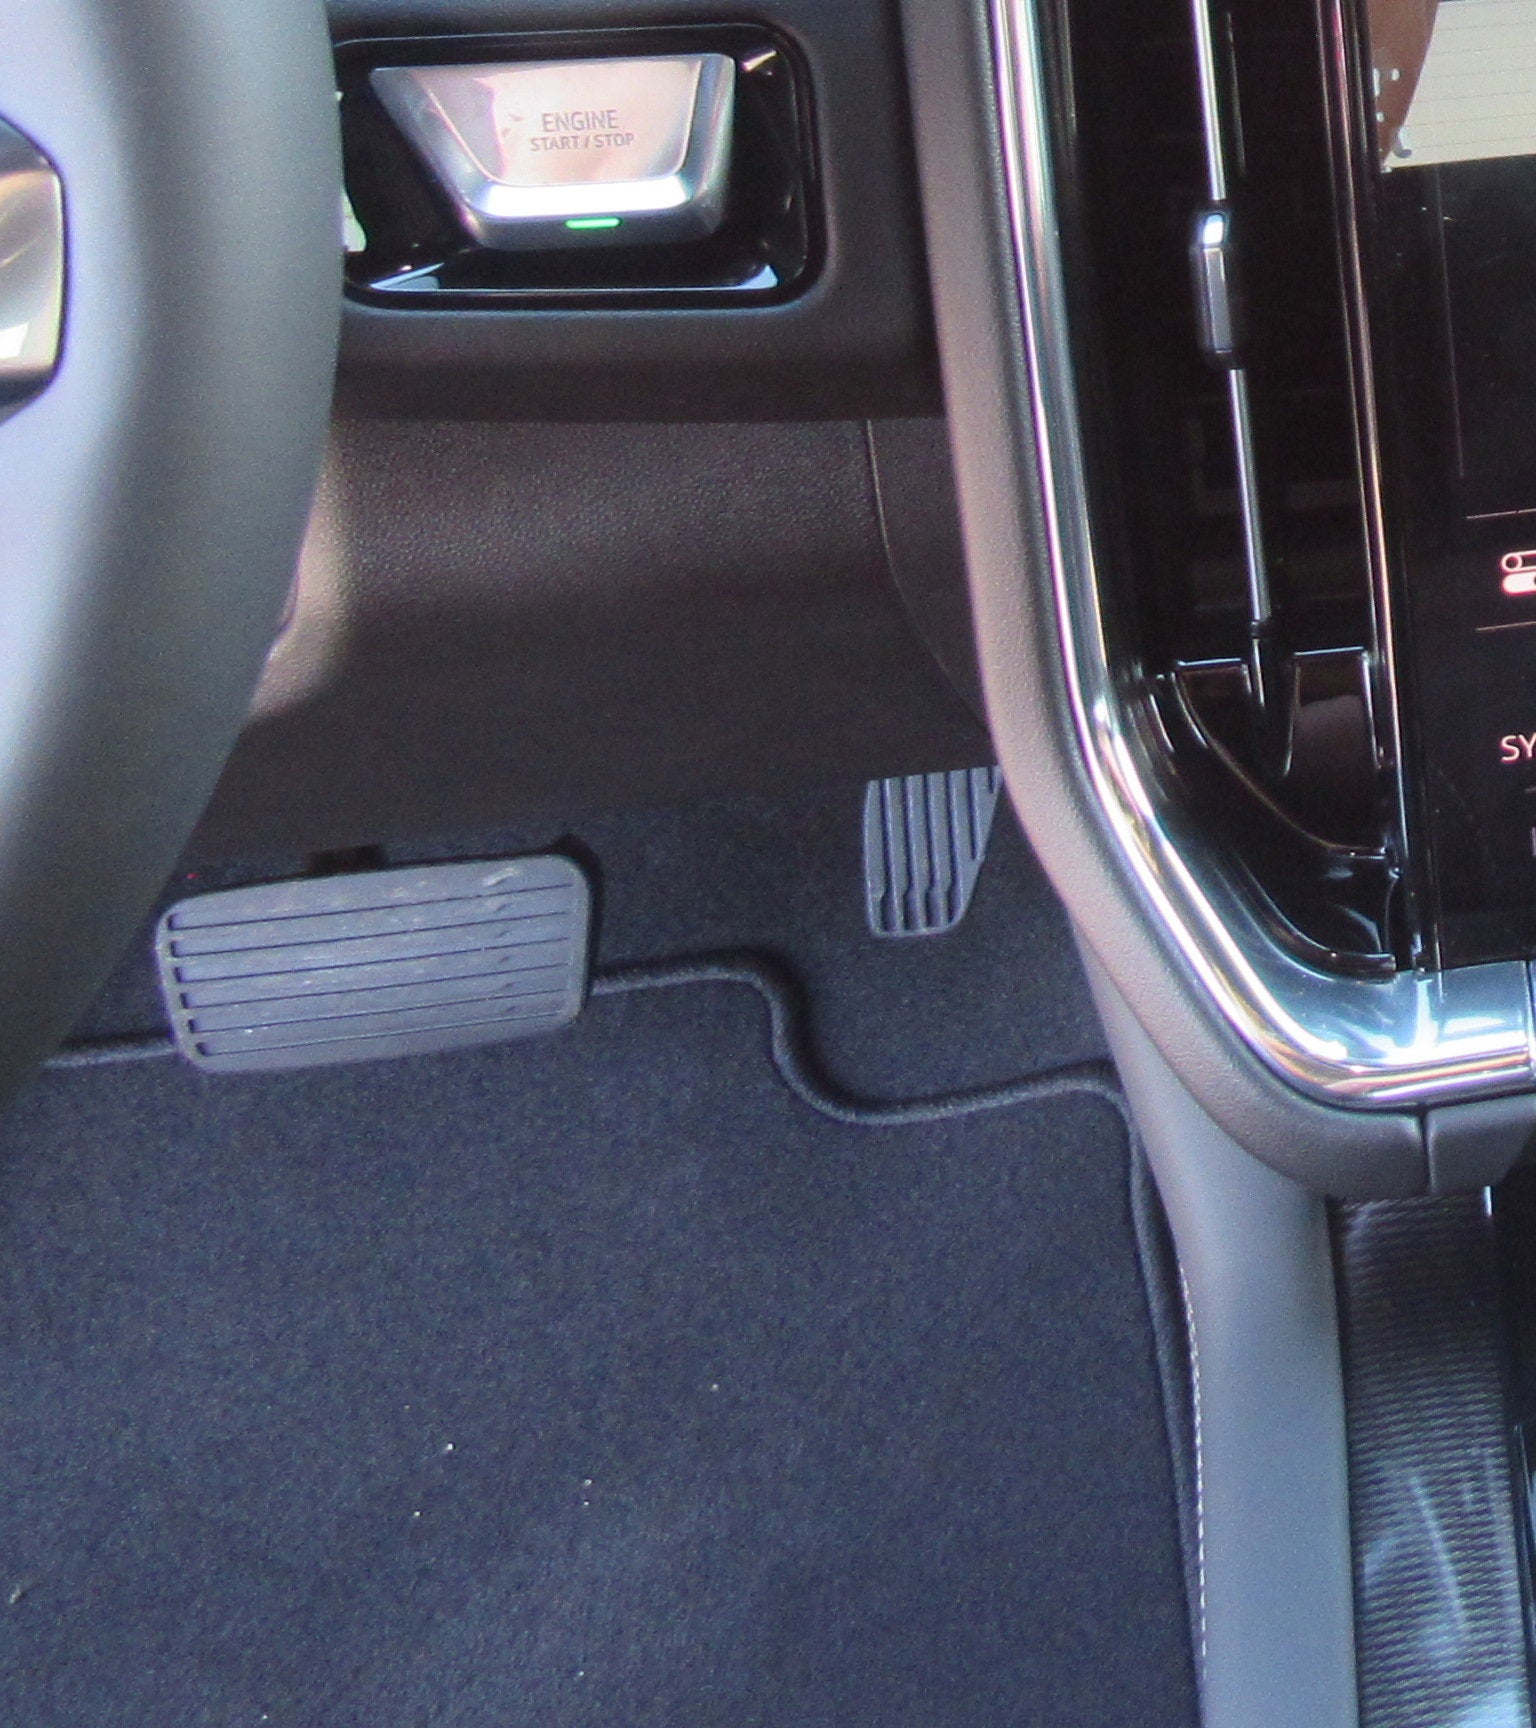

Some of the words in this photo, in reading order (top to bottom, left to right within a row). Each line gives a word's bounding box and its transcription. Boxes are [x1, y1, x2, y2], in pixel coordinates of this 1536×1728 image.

[542, 109, 618, 132] ENGINE
[529, 134, 580, 152] START
[583, 133, 590, 149] /
[594, 132, 635, 150] STOP
